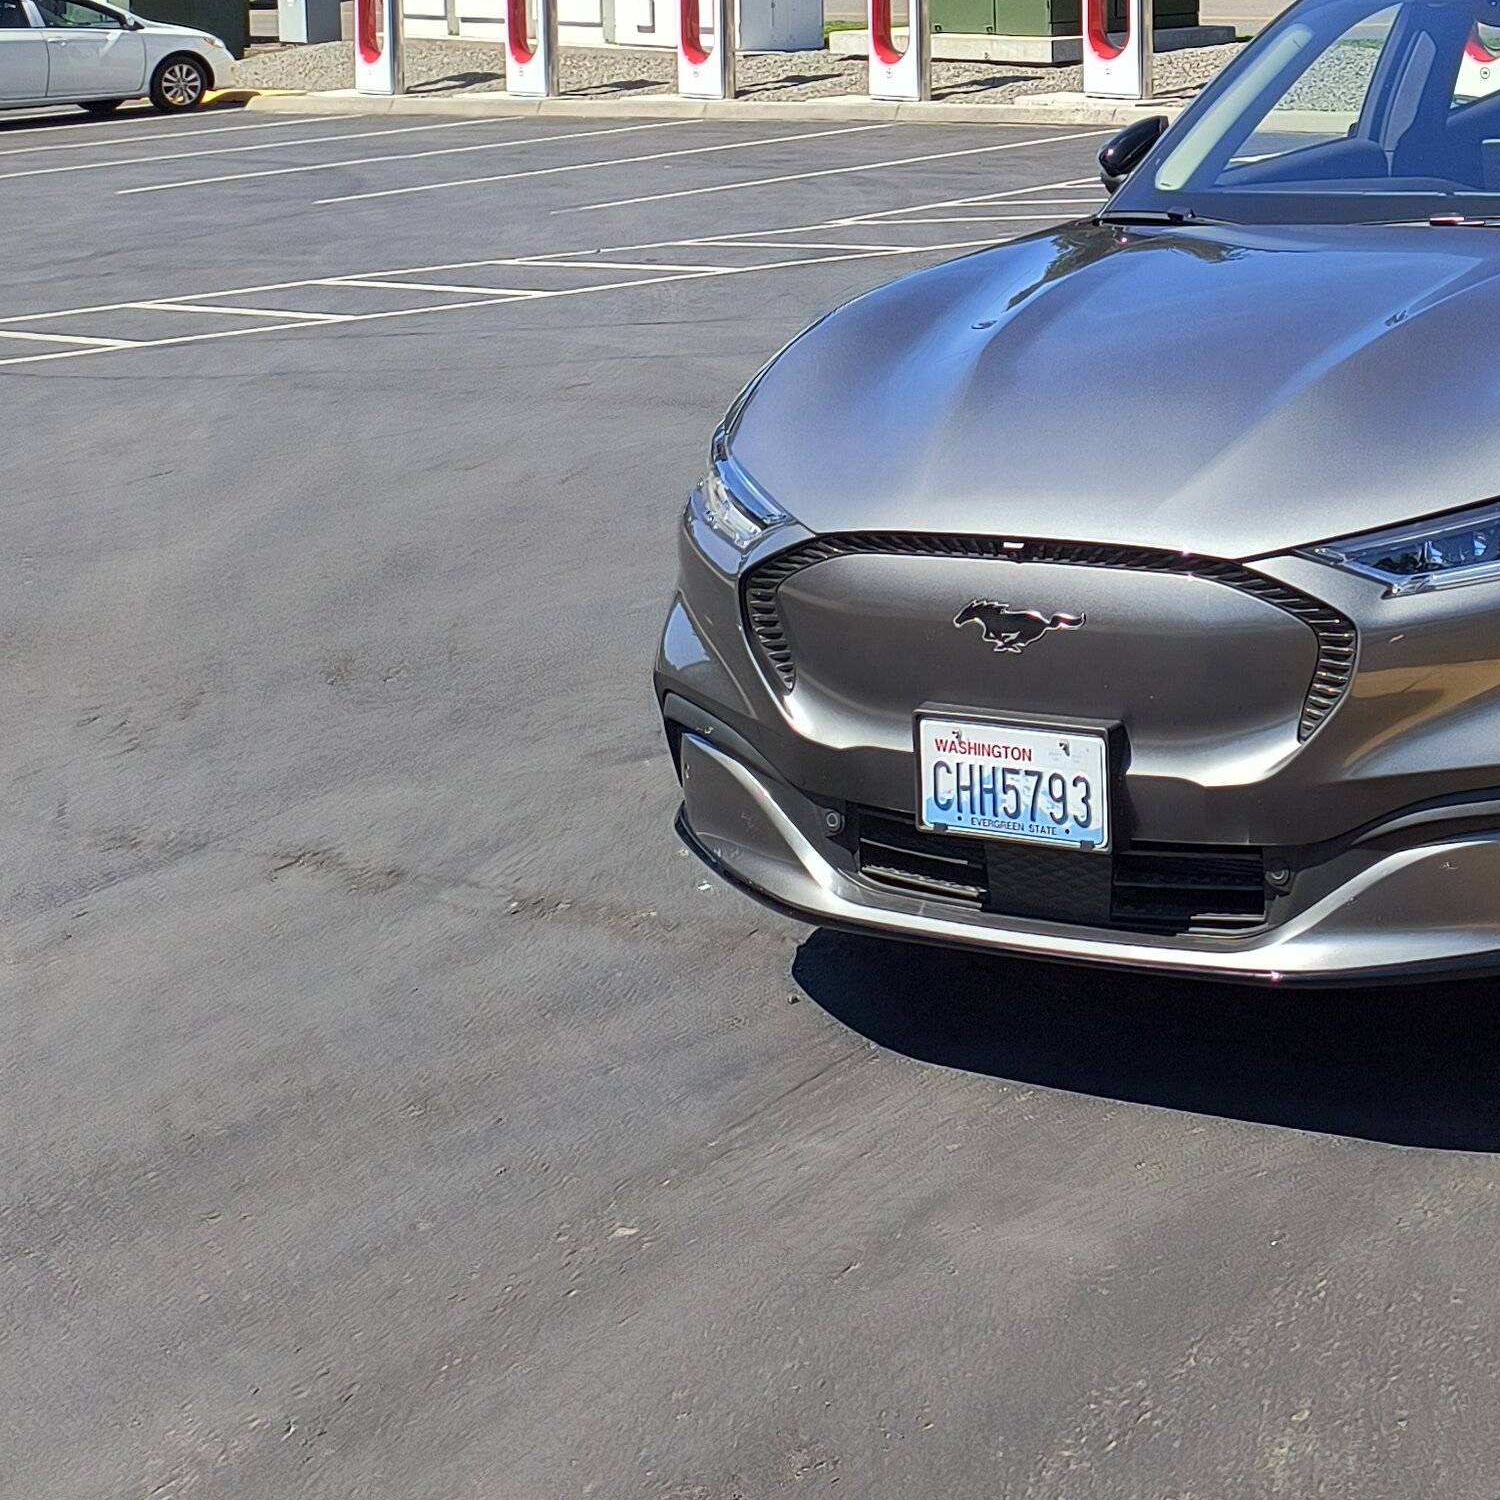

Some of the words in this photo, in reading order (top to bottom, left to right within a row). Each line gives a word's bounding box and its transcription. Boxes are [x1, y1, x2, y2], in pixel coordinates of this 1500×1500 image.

[934, 738, 1032, 762] WASHINGTON
[933, 760, 1092, 829] CHH5793
[971, 817, 1025, 832] EVERGREEN
[1029, 824, 1058, 836] STATE
